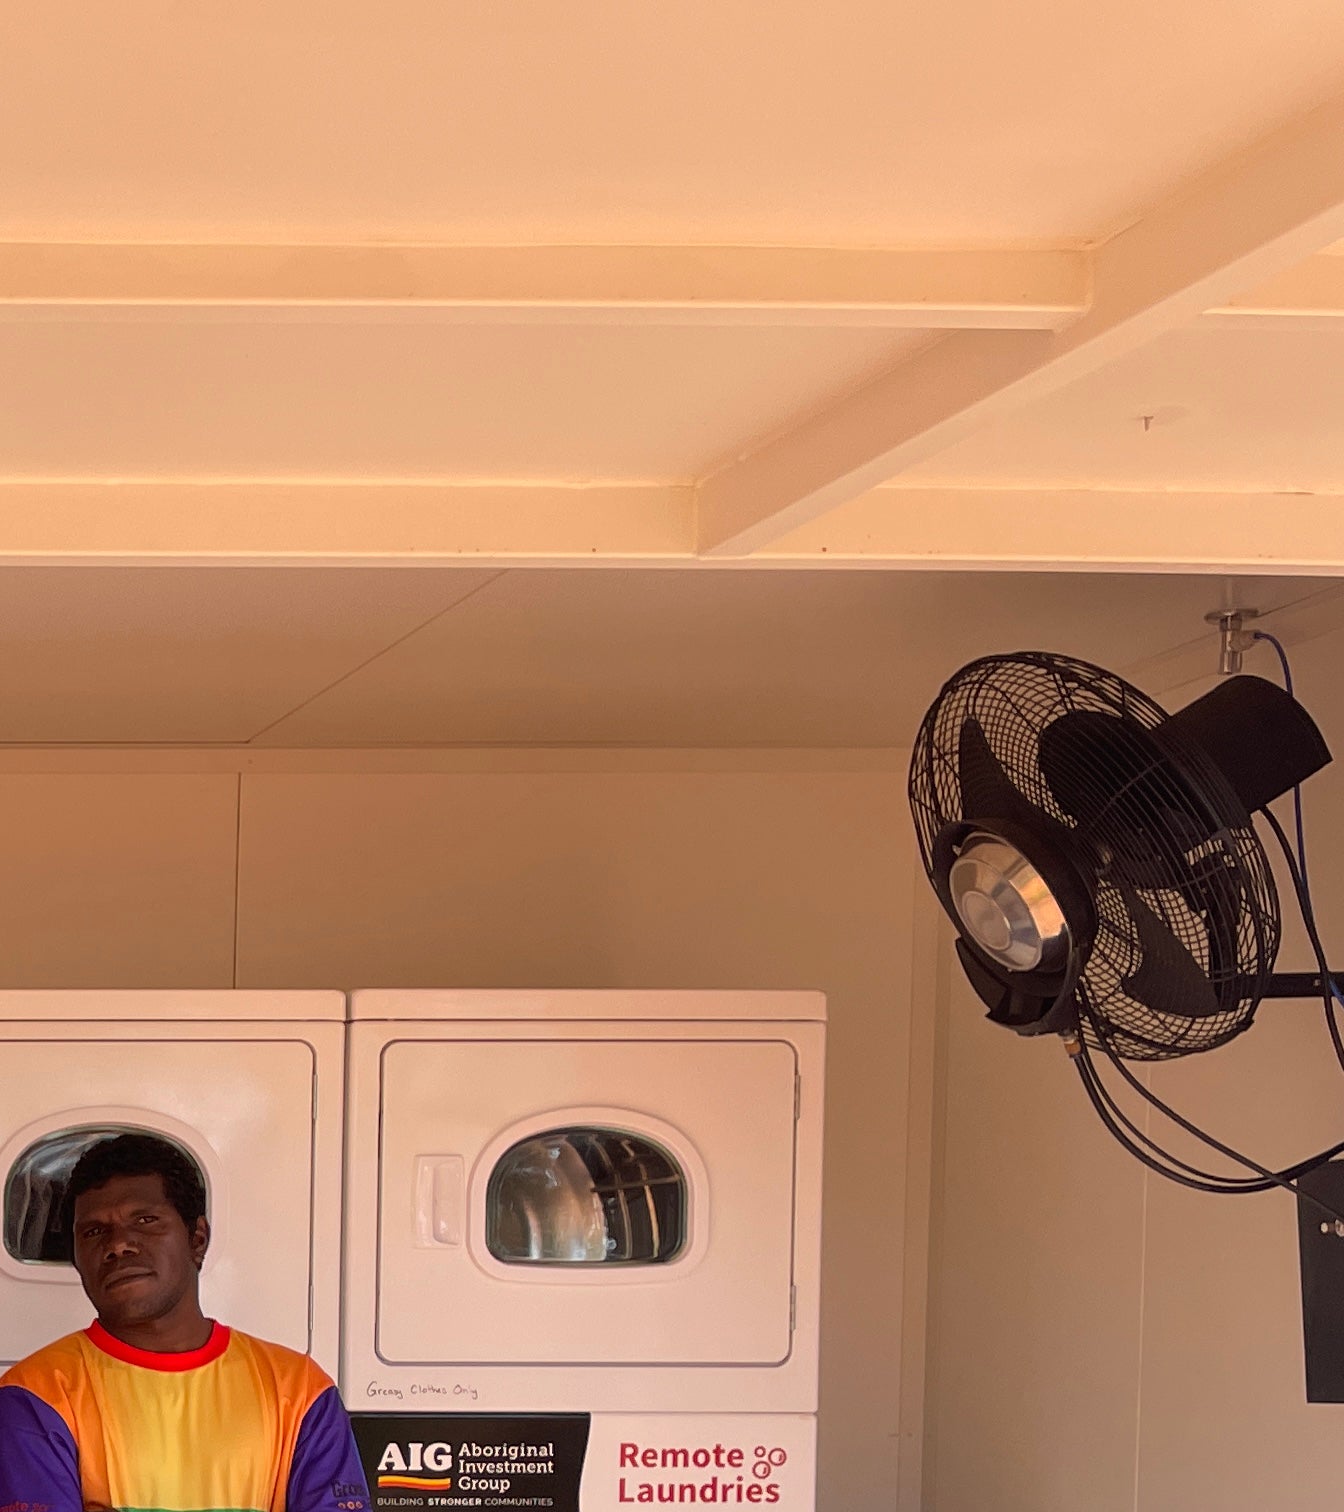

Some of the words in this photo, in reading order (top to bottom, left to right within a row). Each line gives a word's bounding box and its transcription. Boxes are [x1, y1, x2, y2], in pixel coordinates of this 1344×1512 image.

[366, 1380, 403, 1400] Greasy
[377, 1442, 453, 1472] AIG
[458, 1442, 554, 1460] Aboriginal
[618, 1441, 745, 1469] Remote
[458, 1460, 554, 1474] Investment
[458, 1476, 511, 1494] Group
[618, 1475, 781, 1504] Laundries
[377, 1497, 424, 1506] BUILDING
[427, 1497, 482, 1506] STRONGER
[484, 1497, 554, 1506] COMMUNITIES
